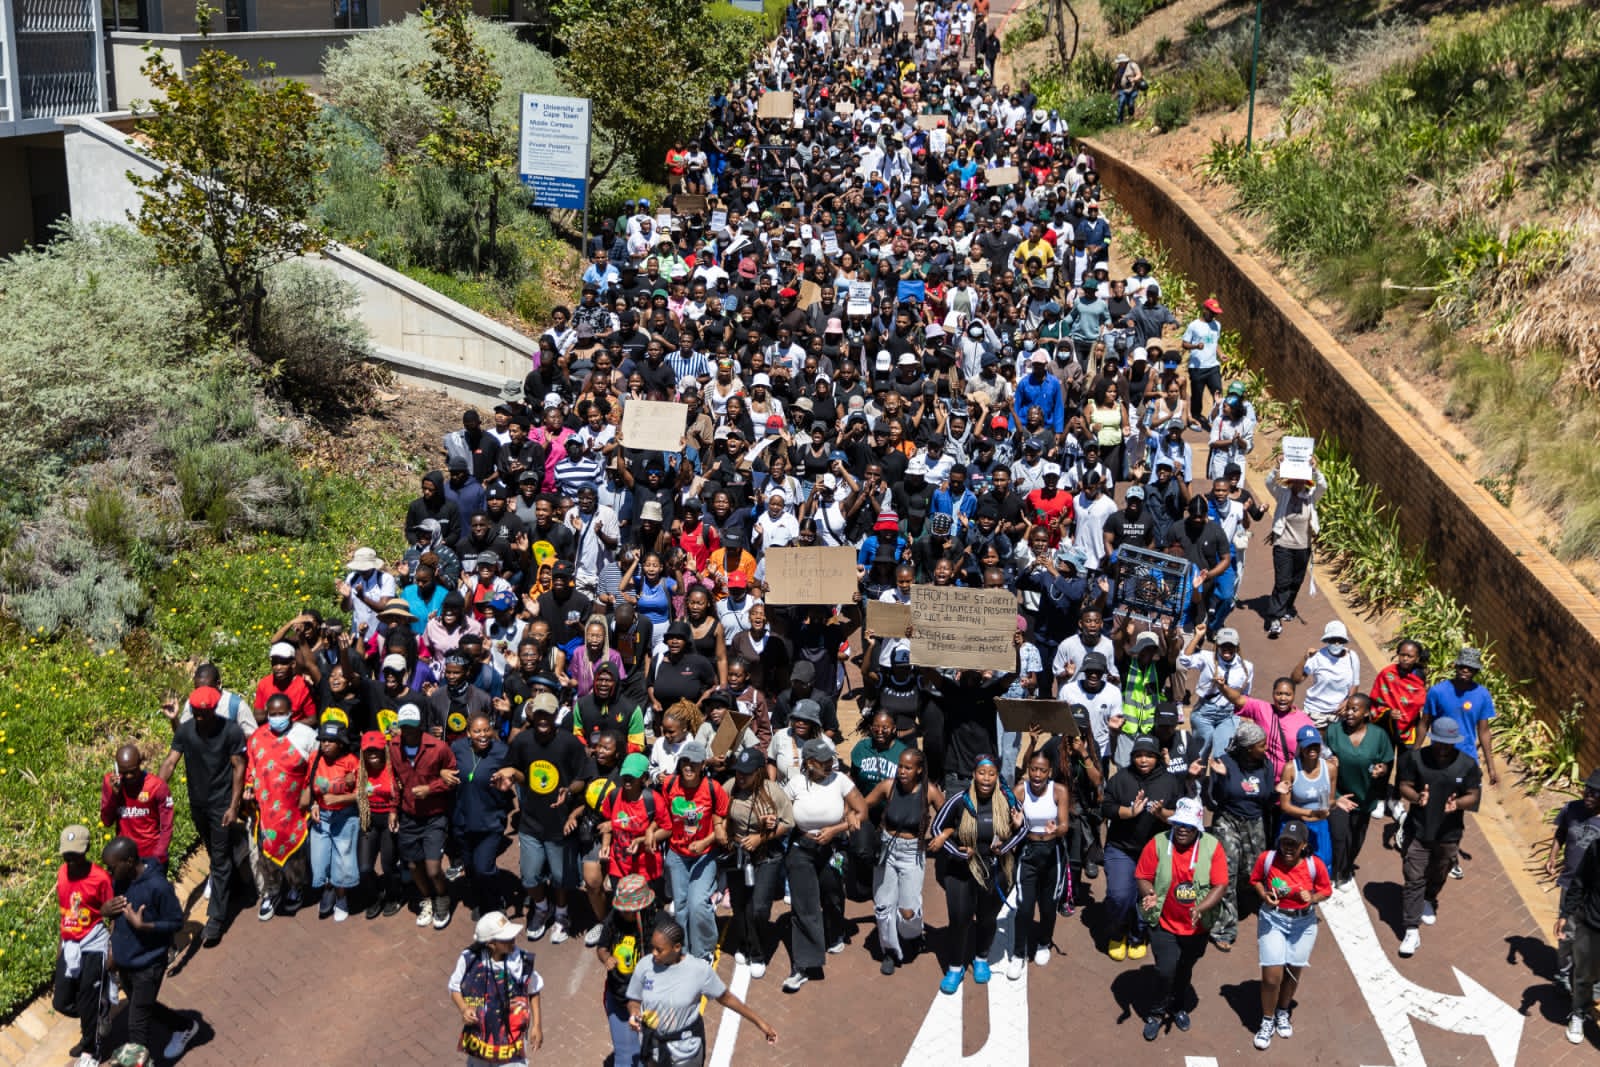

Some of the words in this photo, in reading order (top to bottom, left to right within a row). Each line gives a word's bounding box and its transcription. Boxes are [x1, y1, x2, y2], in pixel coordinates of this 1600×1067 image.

[543, 103, 574, 112] University
[563, 111, 579, 119] Town
[548, 143, 571, 151] Property
[916, 587, 949, 601] FROM
[974, 594, 1015, 606] STUDENT
[912, 601, 928, 611] TO
[932, 603, 982, 614] FINANCIAL
[462, 1032, 494, 1057] VOTE
